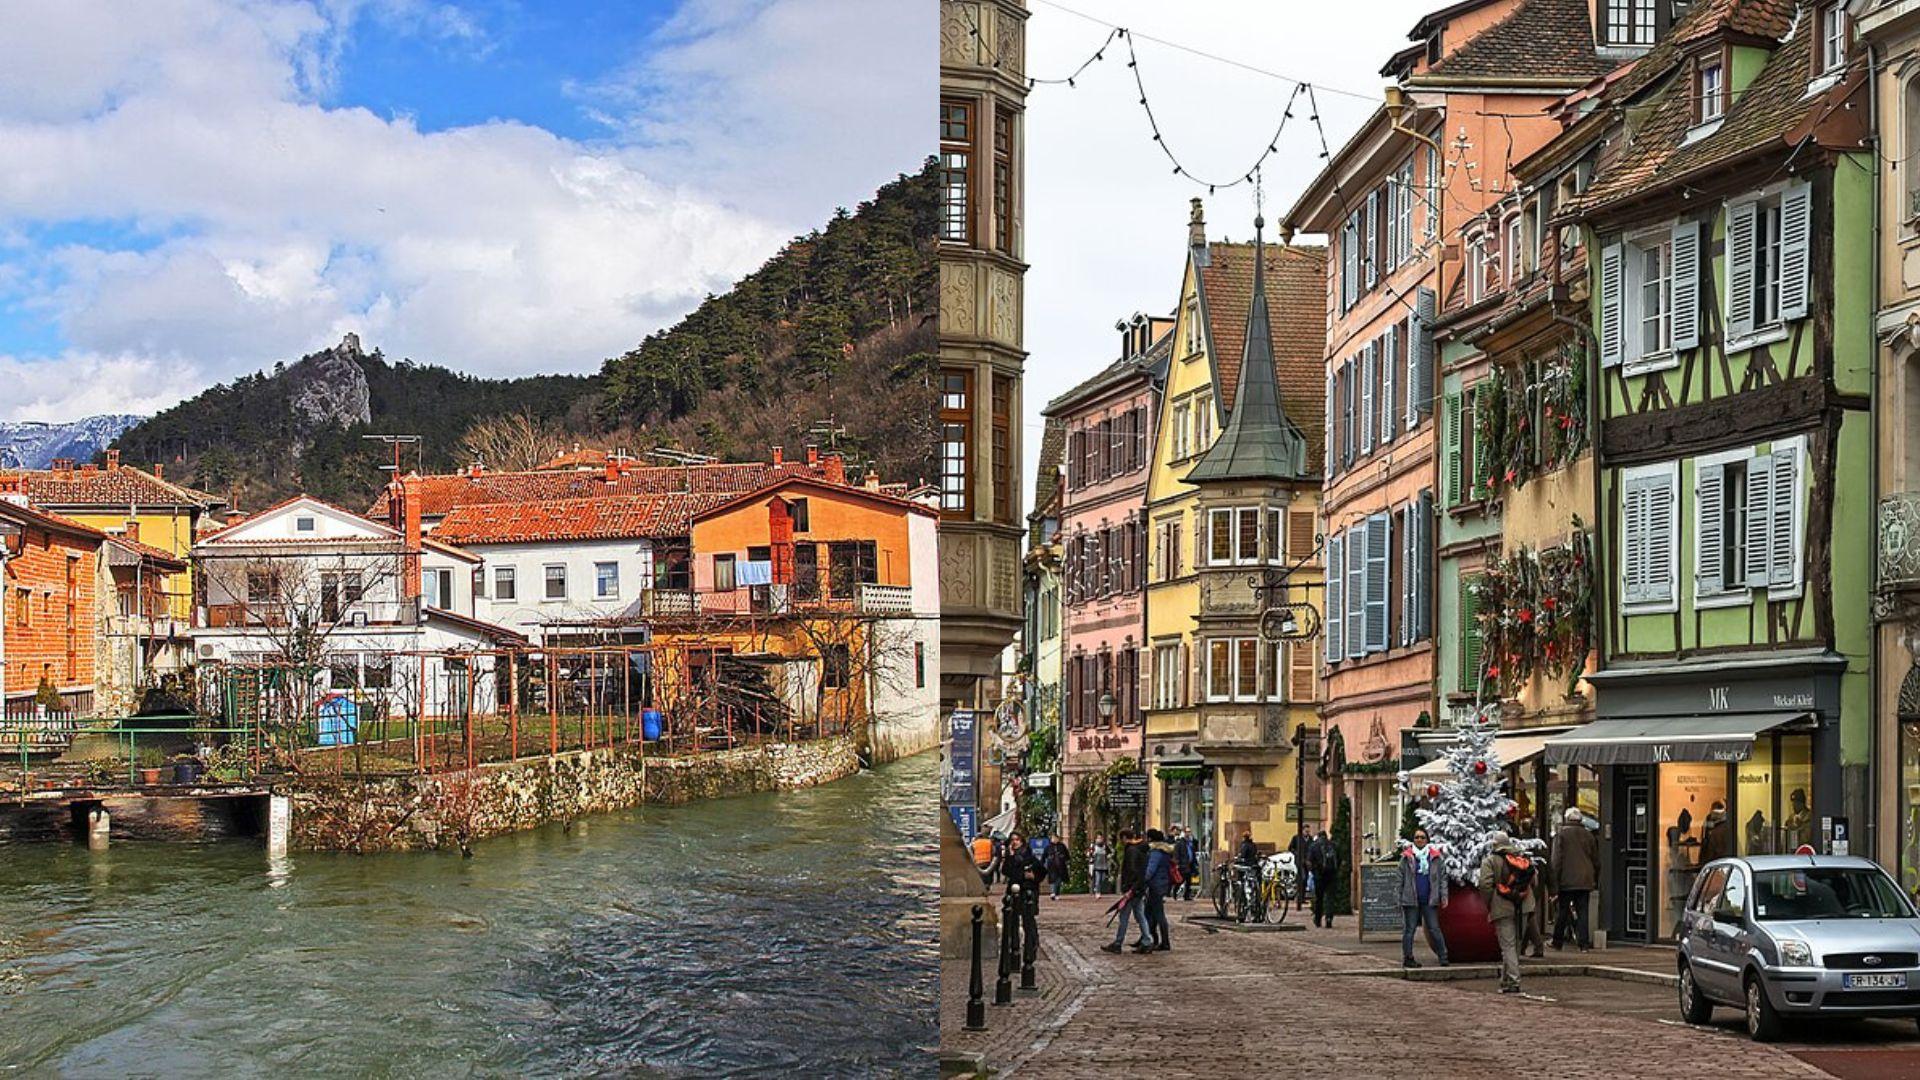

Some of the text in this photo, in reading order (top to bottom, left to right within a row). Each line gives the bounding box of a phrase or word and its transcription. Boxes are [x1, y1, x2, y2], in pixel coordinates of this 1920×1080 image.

[1708, 686, 1729, 710] MK
[1653, 744, 1671, 762] MK
[1835, 823, 1845, 840] P
